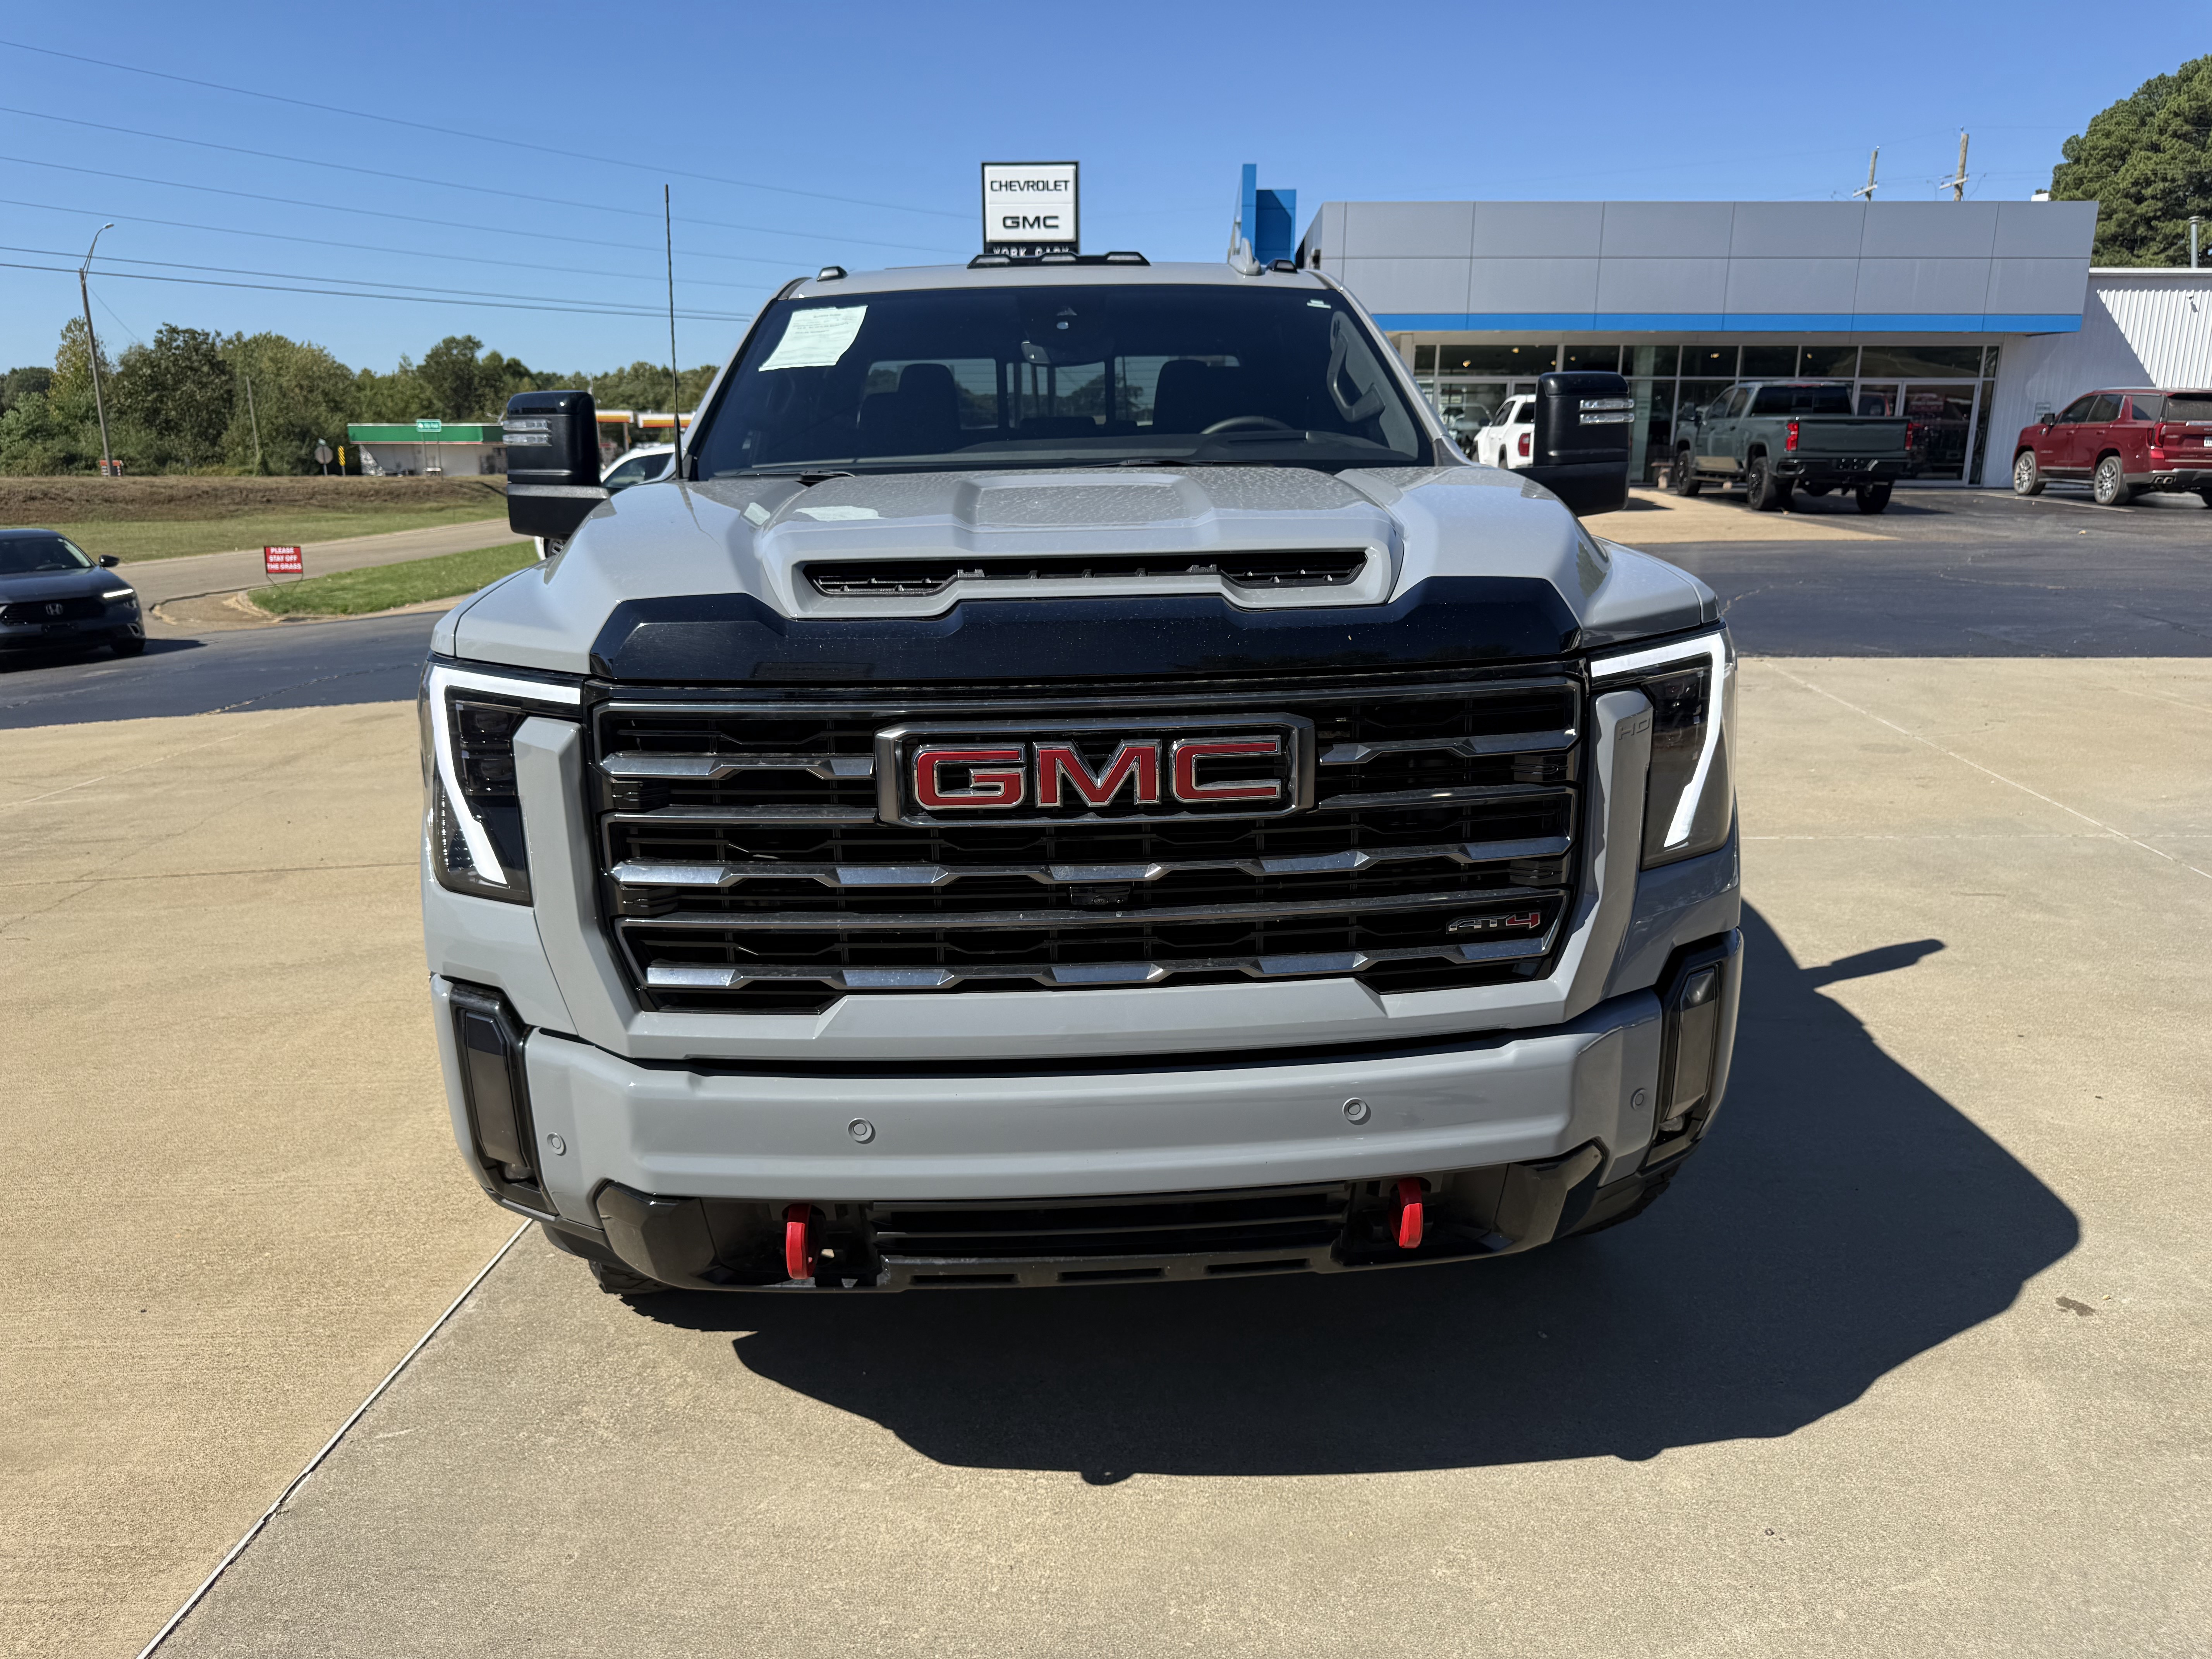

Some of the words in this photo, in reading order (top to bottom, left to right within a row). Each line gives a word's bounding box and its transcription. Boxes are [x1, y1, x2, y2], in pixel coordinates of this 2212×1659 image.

[991, 180, 1070, 191] CHEVROLET
[1003, 216, 1059, 229] GMC
[1618, 717, 1650, 740] HD
[912, 735, 1281, 811] GMC
[1449, 911, 1540, 931] AT4
